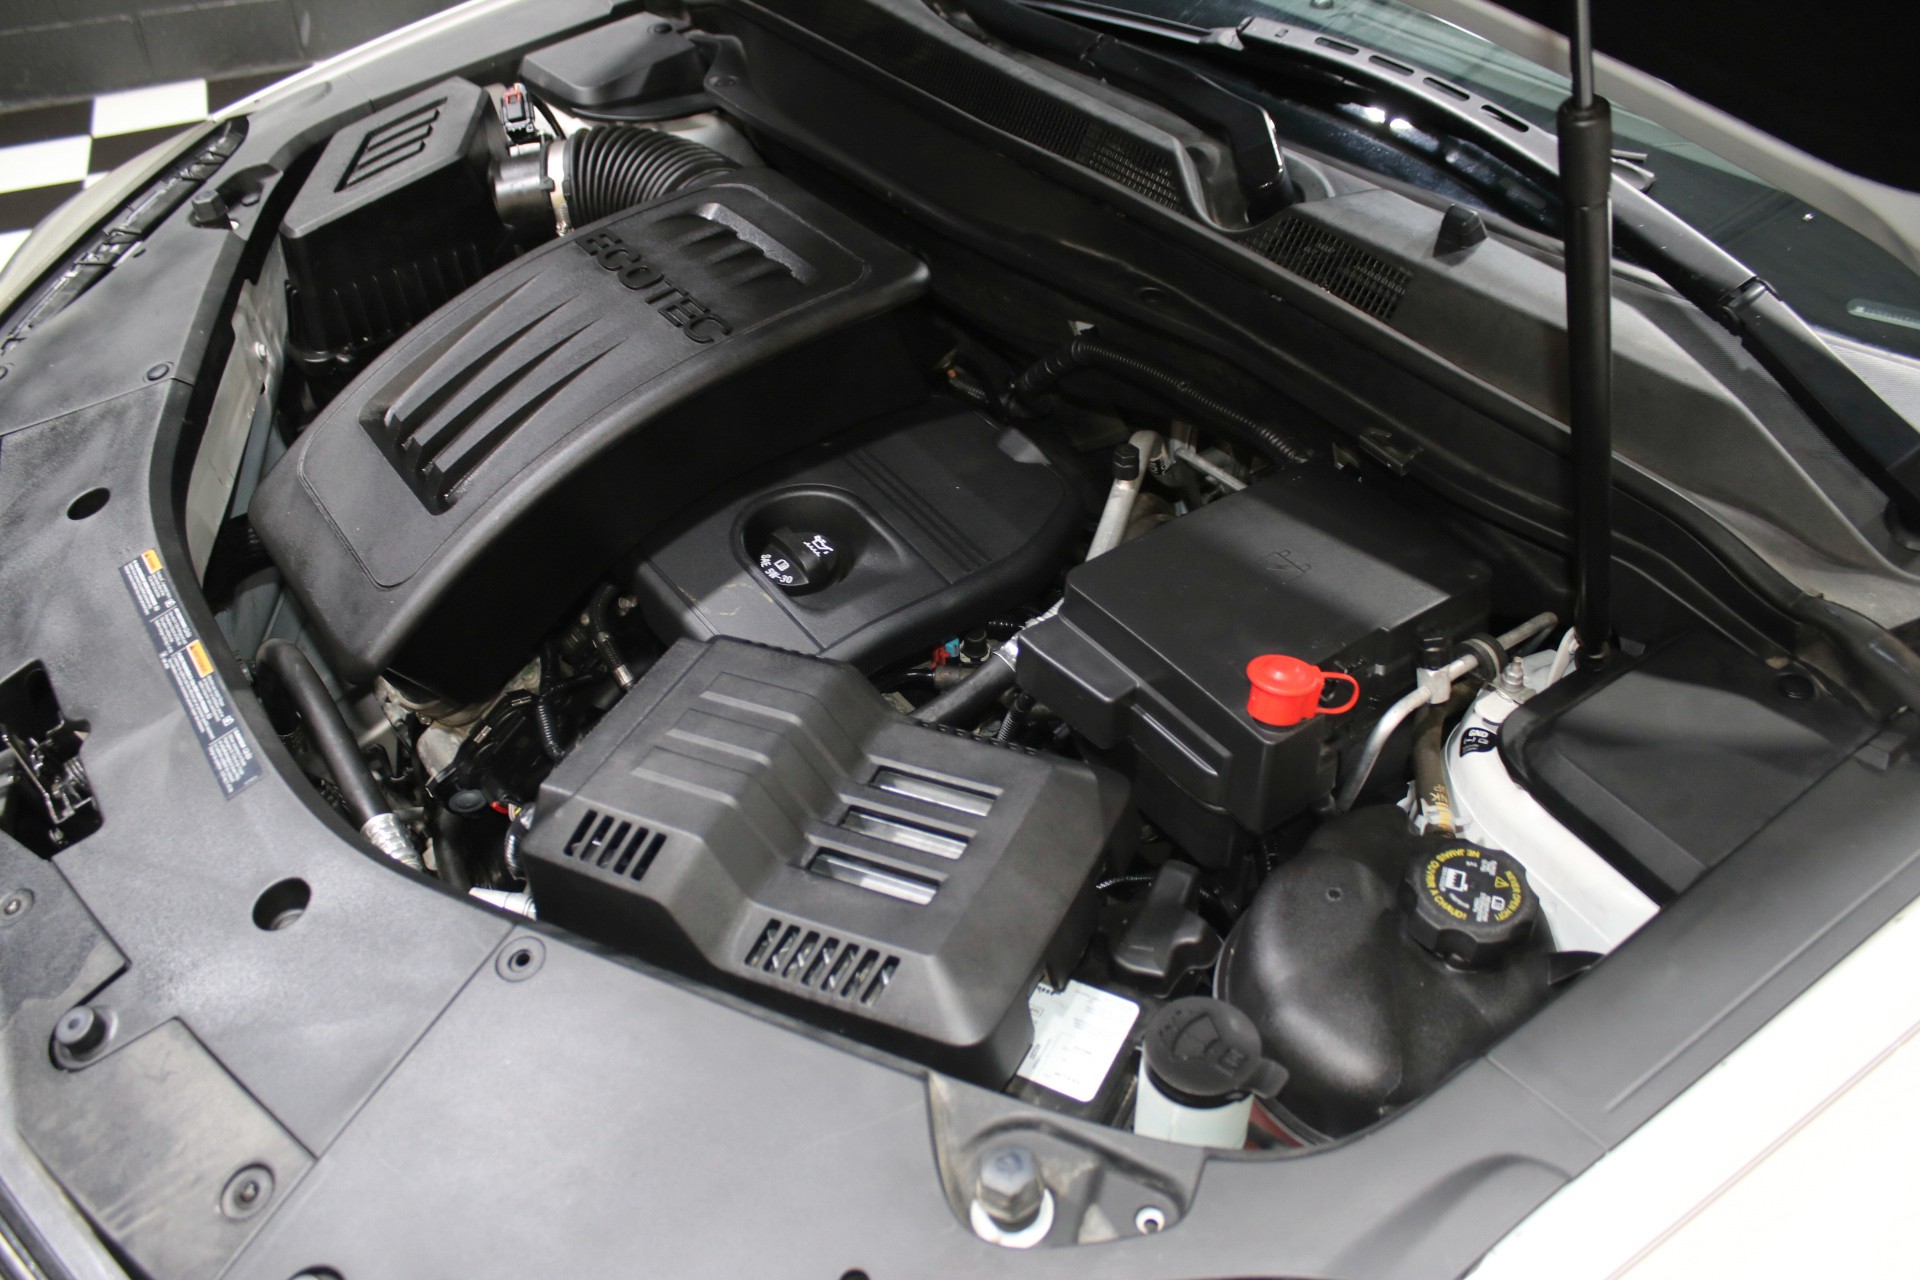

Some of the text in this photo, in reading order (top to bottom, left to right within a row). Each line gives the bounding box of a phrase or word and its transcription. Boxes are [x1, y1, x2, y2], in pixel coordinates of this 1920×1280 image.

[575, 229, 733, 344] ECOTEC
[760, 554, 793, 584] SAE 5W-30
[1436, 849, 1465, 862] JAMAIS
[1466, 849, 1480, 858] NE
